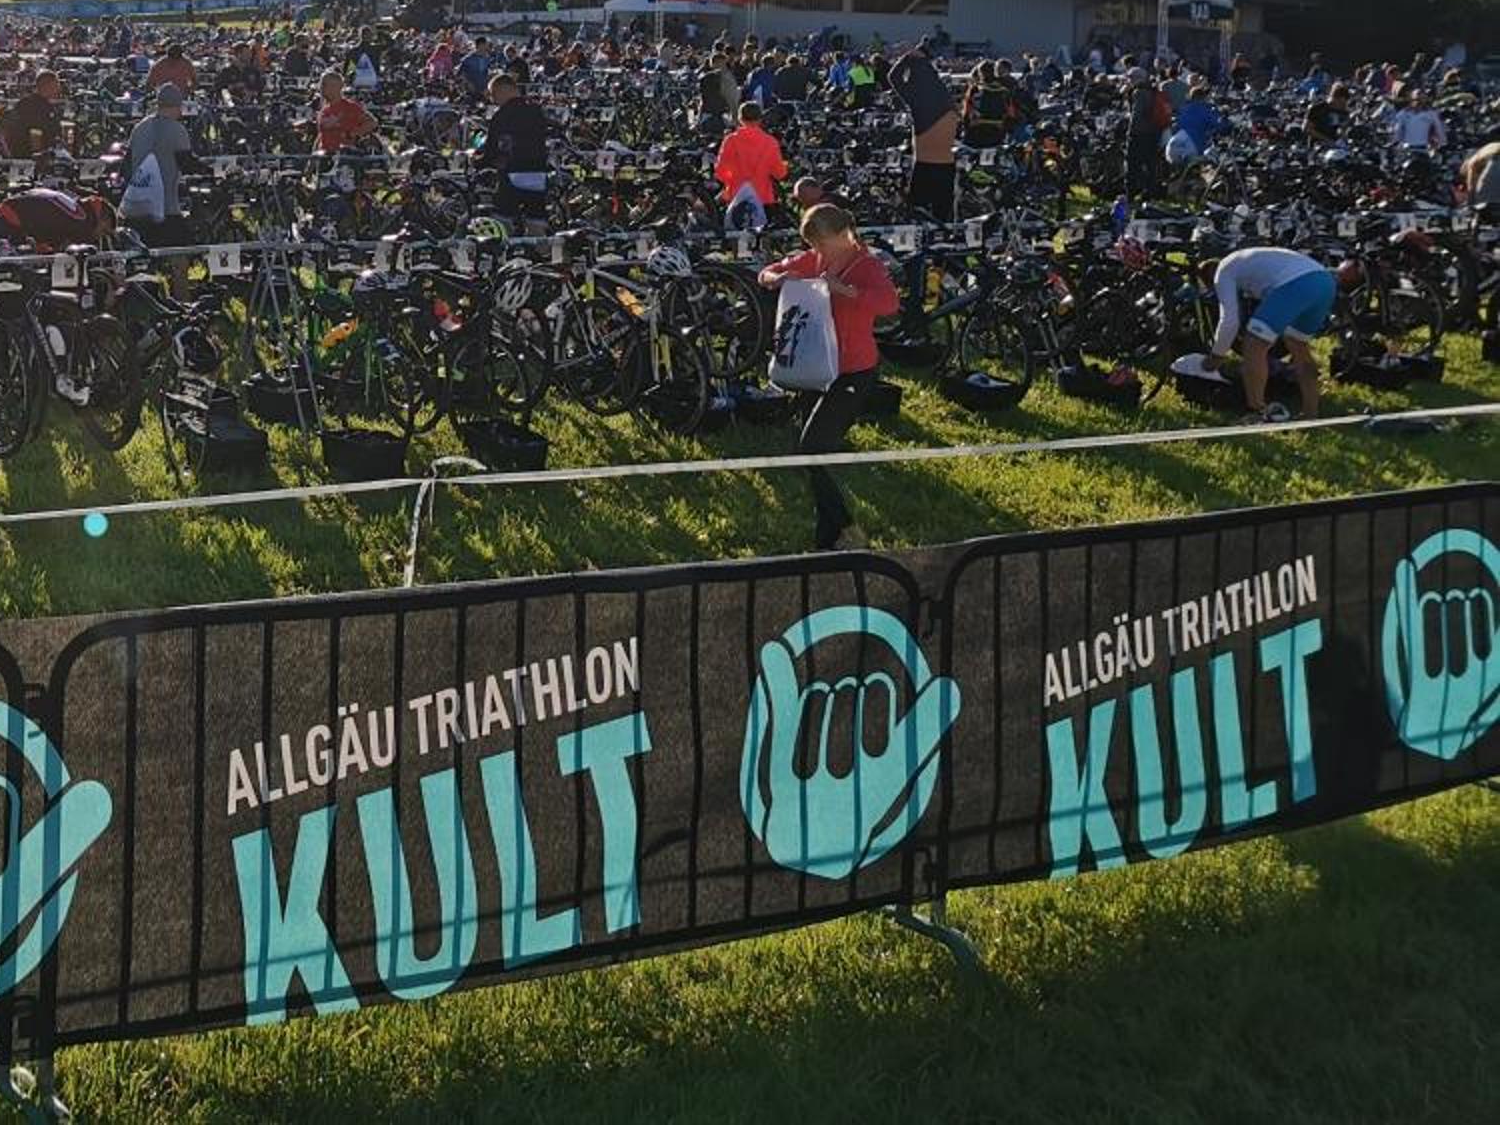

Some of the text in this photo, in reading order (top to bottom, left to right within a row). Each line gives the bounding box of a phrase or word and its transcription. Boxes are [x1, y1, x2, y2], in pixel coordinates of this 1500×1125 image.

[226, 637, 639, 816] ALLGÄU TRIATHLON
[1043, 555, 1317, 707] ALLGÄU TRIATHLON
[1045, 618, 1323, 880] KULT
[232, 711, 652, 1026] KULT
